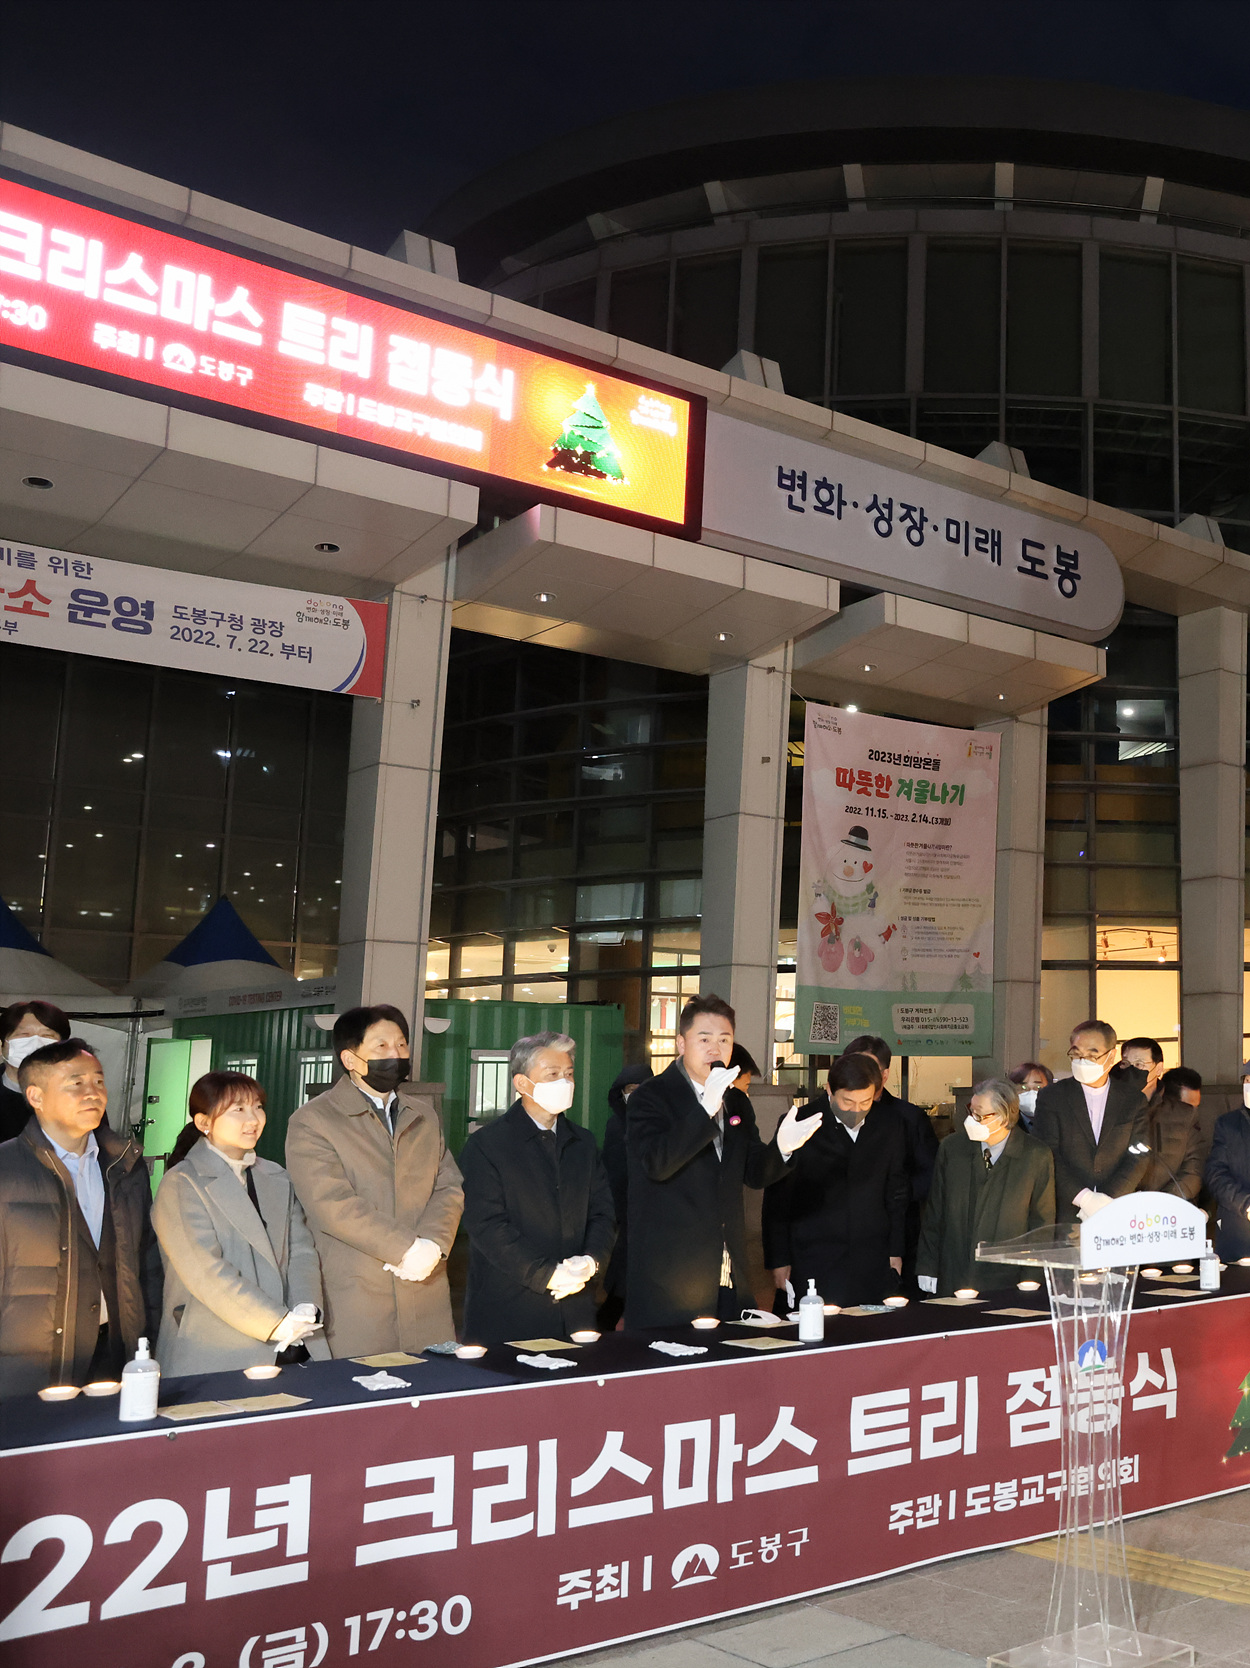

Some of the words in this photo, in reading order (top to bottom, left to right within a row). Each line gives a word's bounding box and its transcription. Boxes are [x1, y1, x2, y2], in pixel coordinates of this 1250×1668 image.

[0, 211, 264, 346] 크리스마스
[278, 302, 373, 379] 트리
[777, 465, 1002, 566] 변화·성장·미래
[1017, 538, 1081, 599] 도봉
[48, 556, 94, 580] 위한
[67, 588, 155, 635] 운영
[172, 604, 244, 632] 도봉구청
[250, 617, 285, 638] 광장
[332, 618, 350, 630] 도봉
[170, 625, 220, 648] 2022.
[226, 634, 242, 652] 7.
[248, 638, 274, 657] 22.
[280, 642, 313, 663] 부터
[868, 749, 902, 766] 2023년
[902, 754, 941, 771] 희망온돌
[835, 767, 893, 798] 따뜻한
[896, 778, 966, 806] 겨울나기
[1130, 1213, 1177, 1230] dobong
[1180, 1226, 1195, 1241] 도봉
[355, 1406, 819, 1567] 크리스마스
[847, 1376, 979, 1476] 트리
[888, 1493, 942, 1535] 주관
[557, 1560, 630, 1611] 주최
[729, 1527, 810, 1570] 도봉구
[344, 1594, 473, 1657] 17:30
